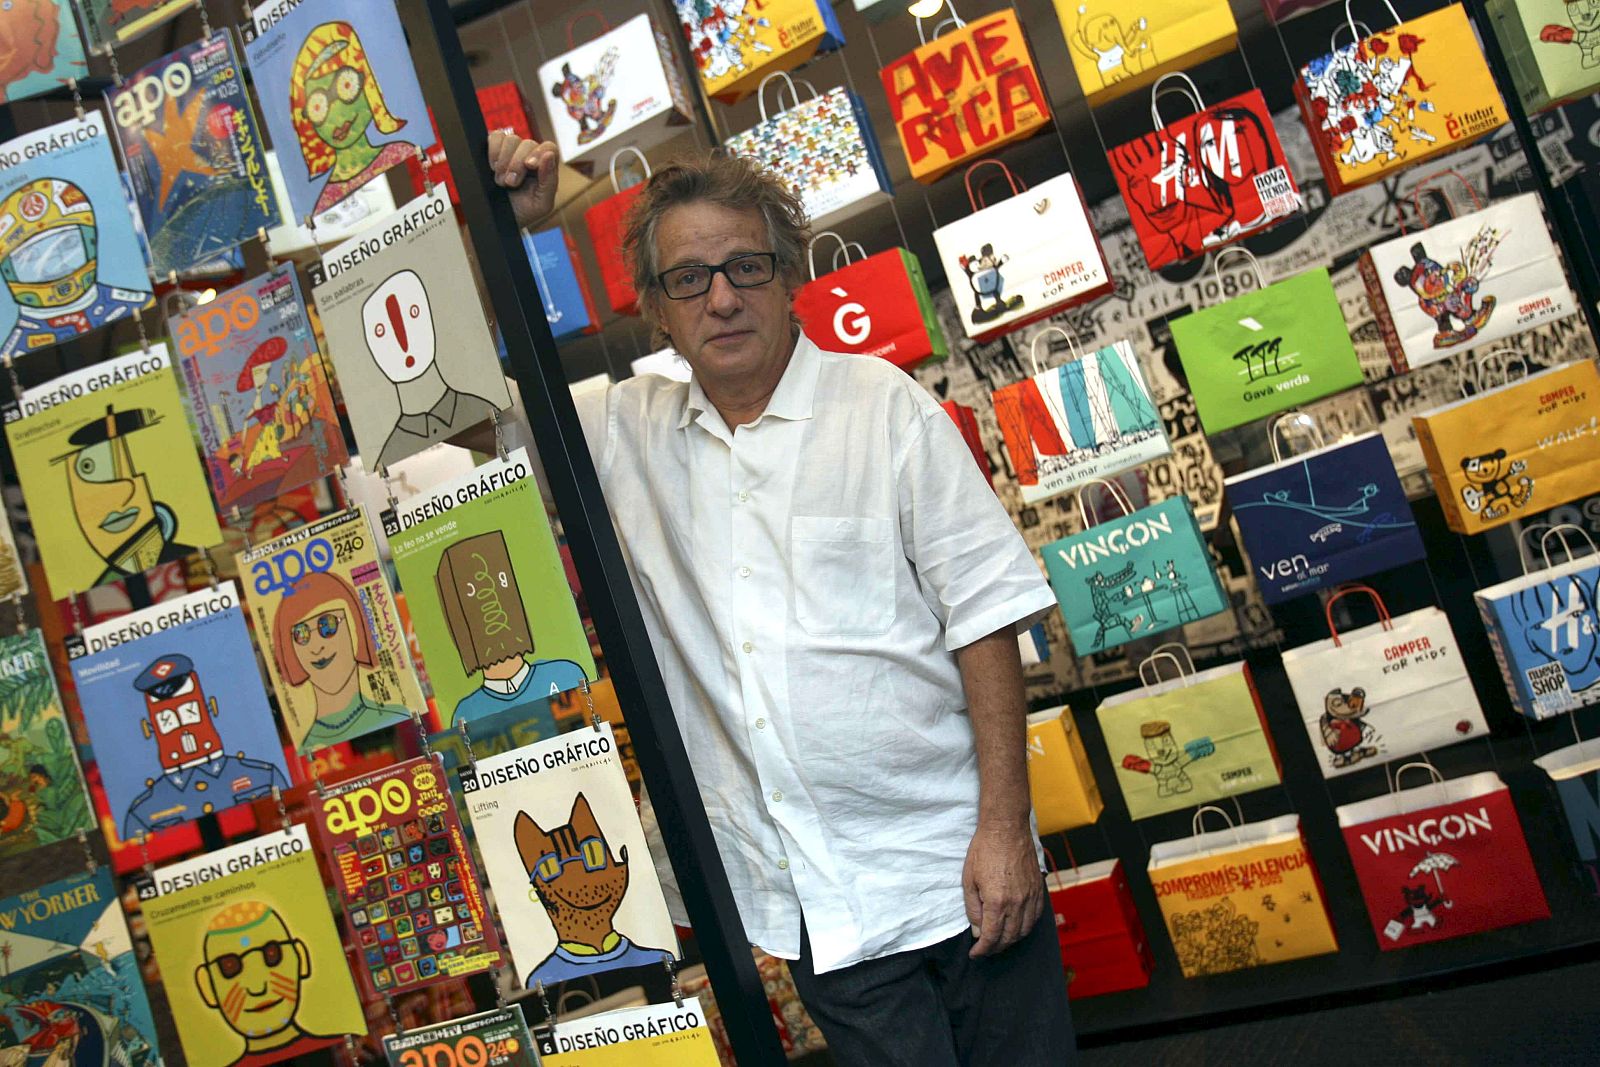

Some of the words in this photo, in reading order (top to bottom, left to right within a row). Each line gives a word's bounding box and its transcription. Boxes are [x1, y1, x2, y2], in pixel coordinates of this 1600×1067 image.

[113, 61, 192, 129] apo
[1464, 105, 1496, 127] futur
[1469, 116, 1500, 134] nostre
[24, 124, 98, 160] GRÁFICO
[1255, 167, 1287, 188] nova
[1260, 182, 1292, 202] TIENDA
[327, 239, 381, 279] DISEÑO
[382, 198, 445, 247] GRÁFICO
[1043, 260, 1085, 287] CAMPER
[1042, 284, 1065, 299] FOR
[1518, 296, 1553, 316] CAMPER
[177, 297, 260, 357] apo
[25, 383, 84, 417] DISEÑO
[87, 356, 163, 393] GRÁFICO
[1242, 385, 1275, 402] Gavà
[1275, 373, 1311, 392] verda
[1539, 384, 1577, 406] CAMPER
[1043, 477, 1065, 491] ven
[1066, 471, 1076, 482] al
[1077, 466, 1099, 478] mar
[385, 521, 399, 536] 23
[402, 494, 454, 531] DISEÑO
[456, 463, 527, 505] GRÁFICO
[403, 537, 415, 550] feo
[416, 534, 425, 544] no
[426, 529, 436, 540] se
[436, 519, 458, 536] vende
[1058, 511, 1173, 570] VINÇON
[251, 537, 335, 599] apo
[1260, 553, 1310, 581] ven
[1308, 562, 1330, 576] mar
[90, 620, 154, 653] DISEÑO
[156, 595, 233, 633] GRÁFICO
[1383, 636, 1432, 662] CAMPER
[1382, 657, 1409, 675] FOR
[1528, 662, 1561, 682] nueva
[1532, 674, 1566, 696] SHOP
[463, 780, 477, 793] 20
[480, 758, 541, 789] DISEÑO
[543, 736, 611, 770] GRÁFICO
[1220, 766, 1253, 782] CAMPER
[322, 777, 413, 838] apo
[472, 800, 500, 814] Lifting
[1361, 807, 1493, 856] VINÇON
[140, 885, 158, 900] 43
[160, 863, 224, 896] DESIGN
[226, 837, 304, 875] GRÁFICO
[543, 1042, 552, 1054] 6
[559, 1027, 620, 1054] DISEÑO
[623, 1011, 699, 1042] GRÁFICO
